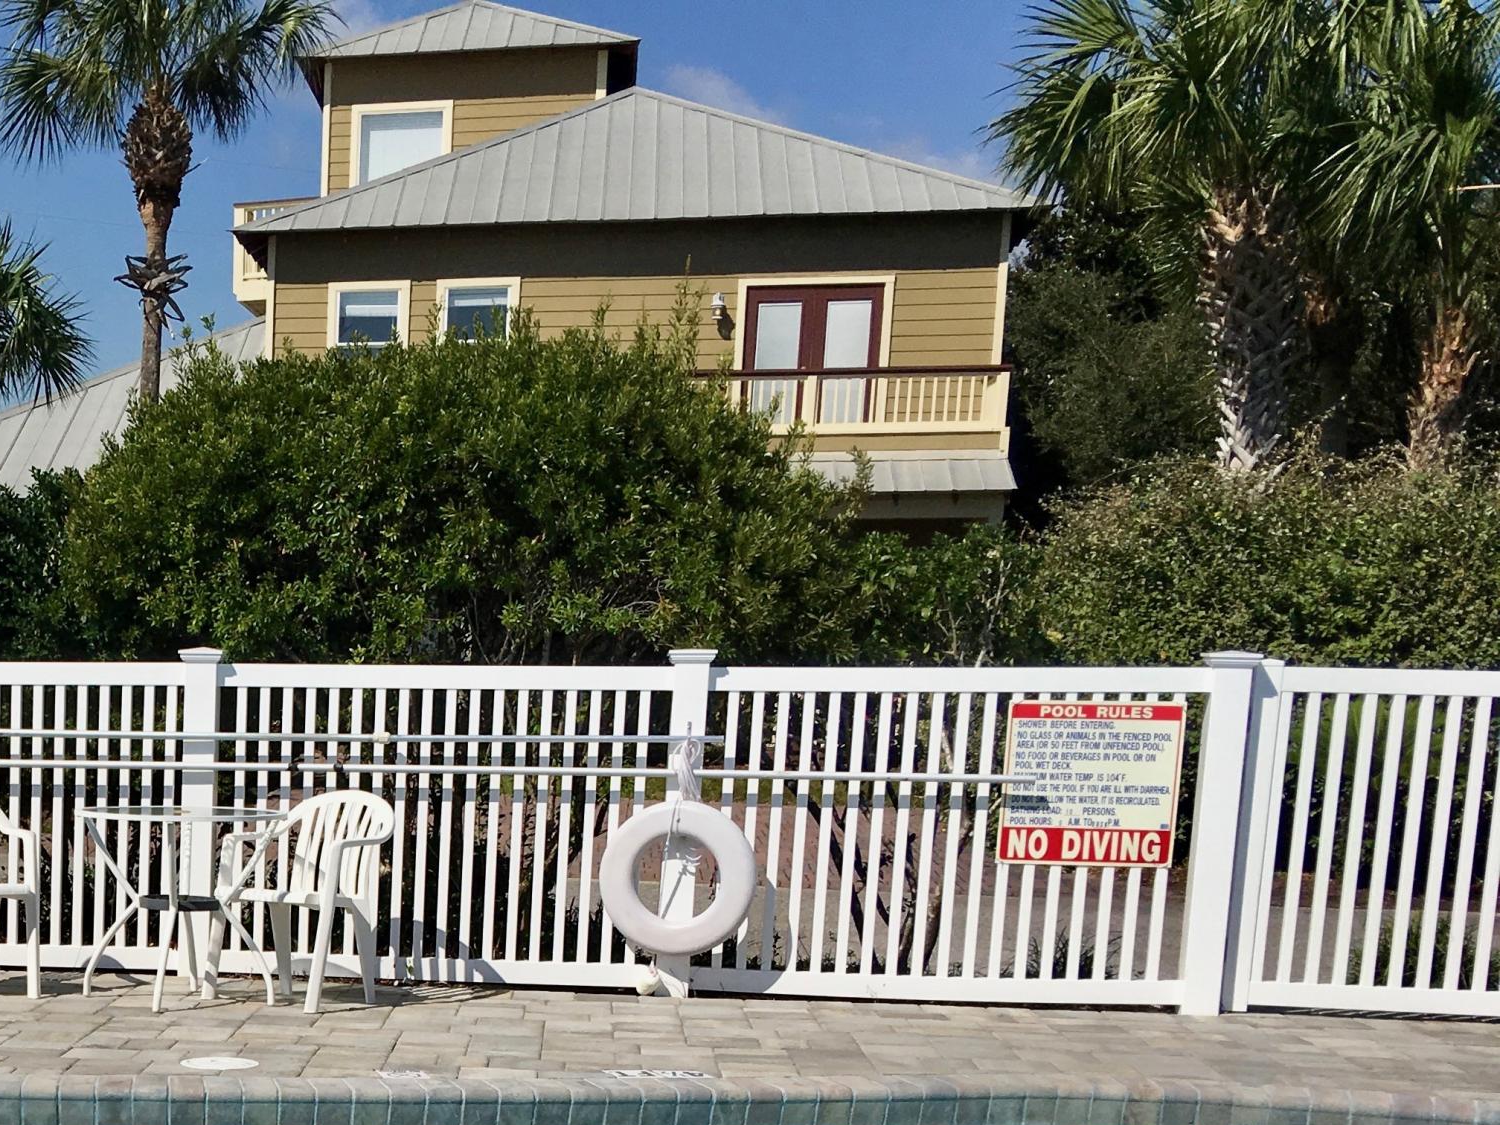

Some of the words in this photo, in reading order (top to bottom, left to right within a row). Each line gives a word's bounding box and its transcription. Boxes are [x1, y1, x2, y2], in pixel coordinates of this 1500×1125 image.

[1040, 705, 1087, 718] POOL
[1096, 706, 1153, 719] RULES
[1018, 720, 1046, 729] SHOWER
[1050, 720, 1077, 729] BEFORE
[1017, 731, 1027, 740] NO
[1030, 731, 1051, 740] GLASS
[1054, 731, 1064, 740] OR
[1066, 732, 1097, 740] ANIMALS
[1099, 732, 1106, 740] IN
[1108, 732, 1121, 741] THE
[1124, 732, 1151, 741] FENCED
[1154, 733, 1173, 742] POOL
[1017, 740, 1034, 749] AREA
[1051, 741, 1059, 750] 50
[1062, 741, 1078, 750] FEET
[1080, 741, 1101, 750] FROM
[1103, 742, 1140, 751] UNFENCED
[1015, 751, 1025, 760] NO
[1028, 751, 1047, 760] FOOD
[1050, 752, 1059, 760] OR
[1060, 752, 1101, 761] BEVERAGES
[1103, 753, 1110, 761] IN
[1112, 753, 1130, 762] POOL
[1133, 754, 1143, 762] OR
[1145, 754, 1156, 762] ON
[1015, 760, 1033, 769] POOL
[1036, 761, 1049, 770] WET
[1050, 772, 1072, 781] WATER
[1097, 774, 1104, 782] IS
[1012, 783, 1020, 791] DO
[1023, 783, 1035, 791] NOT
[1036, 784, 1048, 792] USE
[1049, 784, 1060, 792] THE
[1062, 784, 1077, 793] POOL
[1080, 785, 1085, 793] IF
[1087, 785, 1099, 793] YOU
[1100, 785, 1111, 793] ARE
[1113, 785, 1121, 793] ILL
[1123, 785, 1139, 794] WITH
[1011, 795, 1020, 803] DO
[1021, 795, 1033, 803] NOT
[1066, 795, 1077, 804] THE
[1101, 796, 1107, 804] IT
[1108, 796, 1114, 805] IS
[1011, 805, 1040, 815] BATHING
[1010, 816, 1027, 825] POOL
[1007, 829, 1048, 859] NO
[1061, 830, 1161, 862] DIVING
